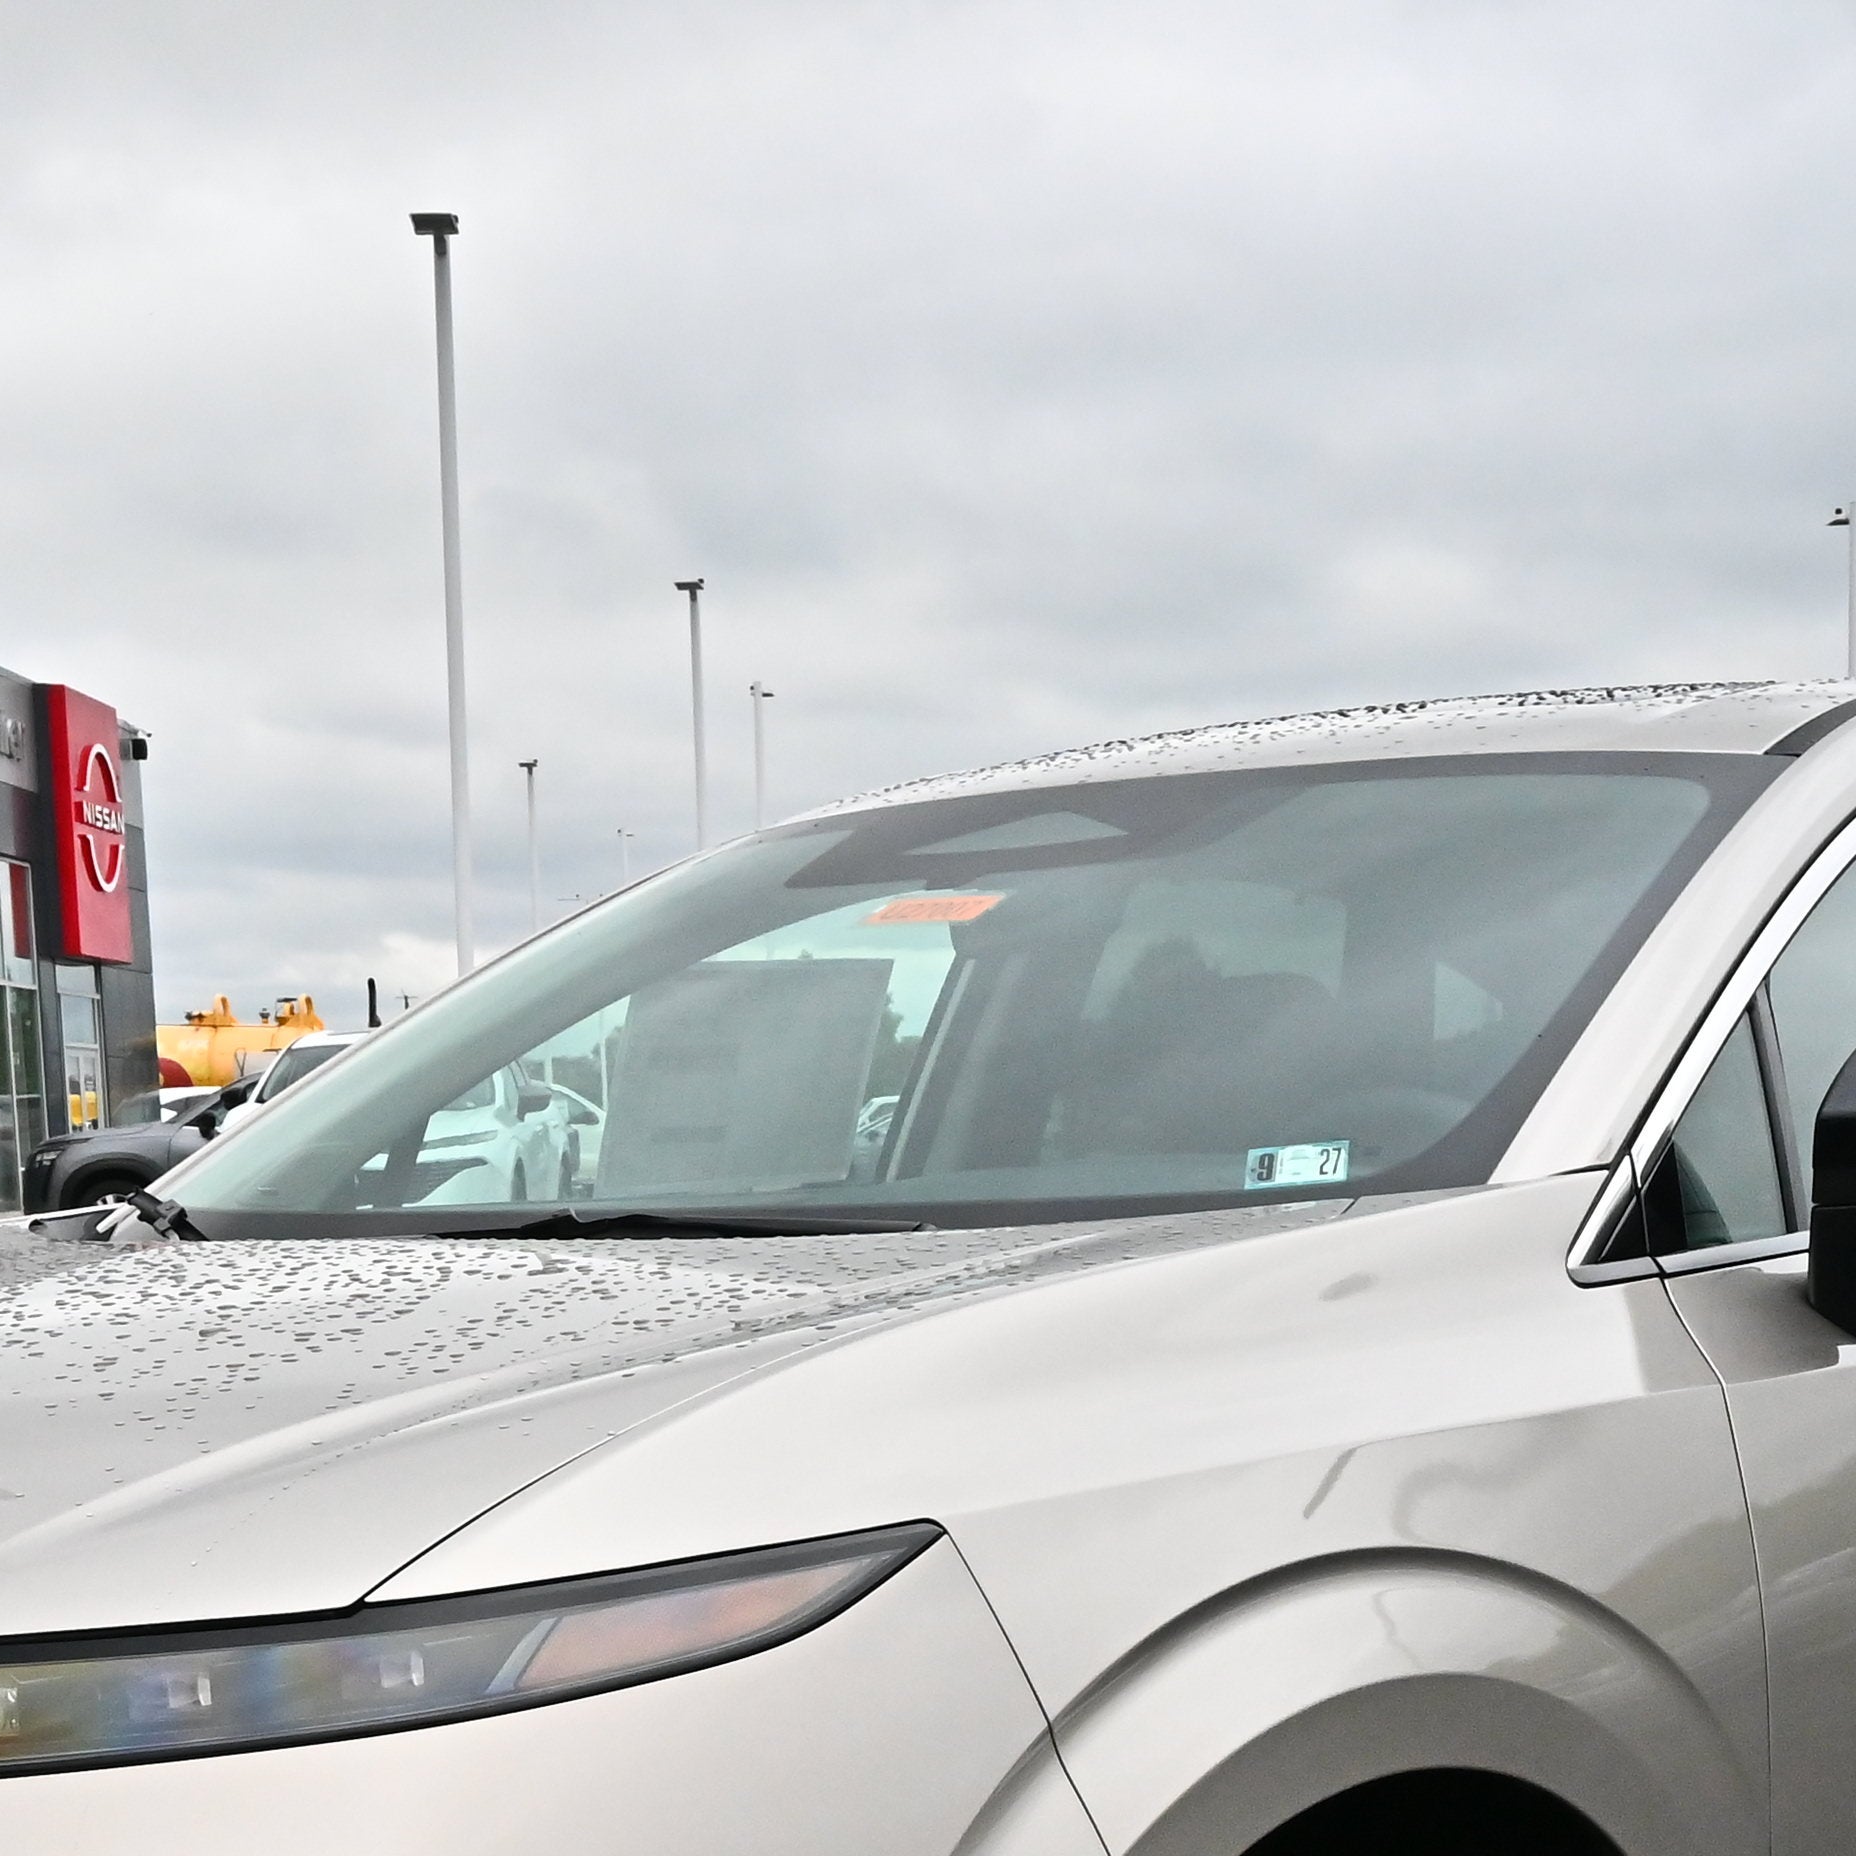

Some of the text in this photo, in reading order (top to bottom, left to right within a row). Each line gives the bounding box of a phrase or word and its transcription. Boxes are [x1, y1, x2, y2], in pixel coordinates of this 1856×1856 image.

[83, 800, 125, 835] NISSAN
[1257, 1153, 1275, 1181] 9
[1319, 1147, 1342, 1176] 27
